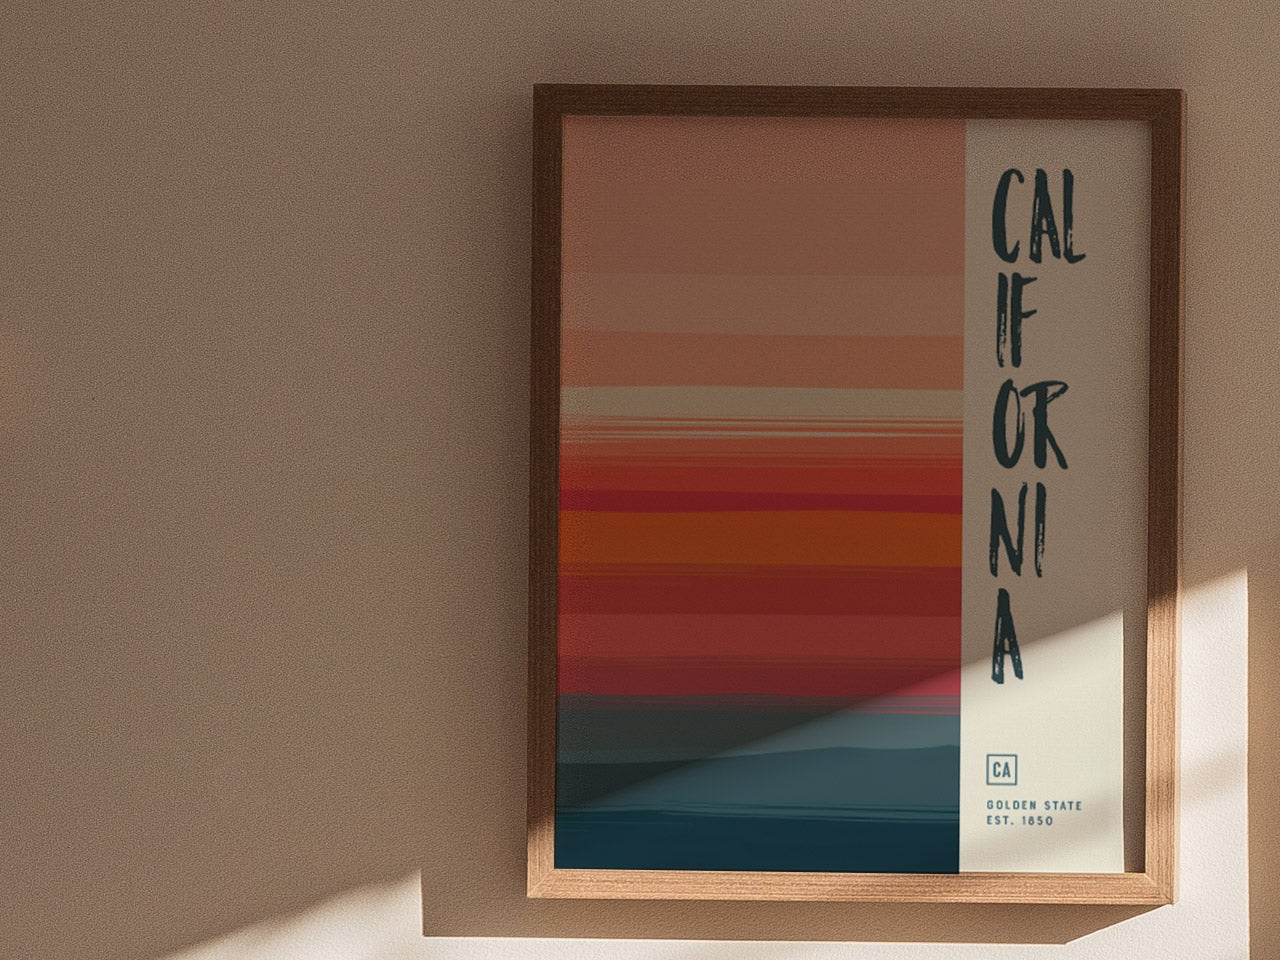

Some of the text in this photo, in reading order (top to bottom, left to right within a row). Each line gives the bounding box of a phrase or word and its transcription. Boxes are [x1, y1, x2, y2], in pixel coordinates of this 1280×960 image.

[992, 168, 1086, 264] CAL
[996, 272, 1037, 368] IF
[992, 379, 1069, 469] OR
[989, 482, 1046, 578] NI
[992, 588, 1023, 684] A
[987, 800, 1081, 811] GOLDEN STATE
[993, 762, 1011, 777] CA
[987, 815, 1053, 826] EST. 1850
